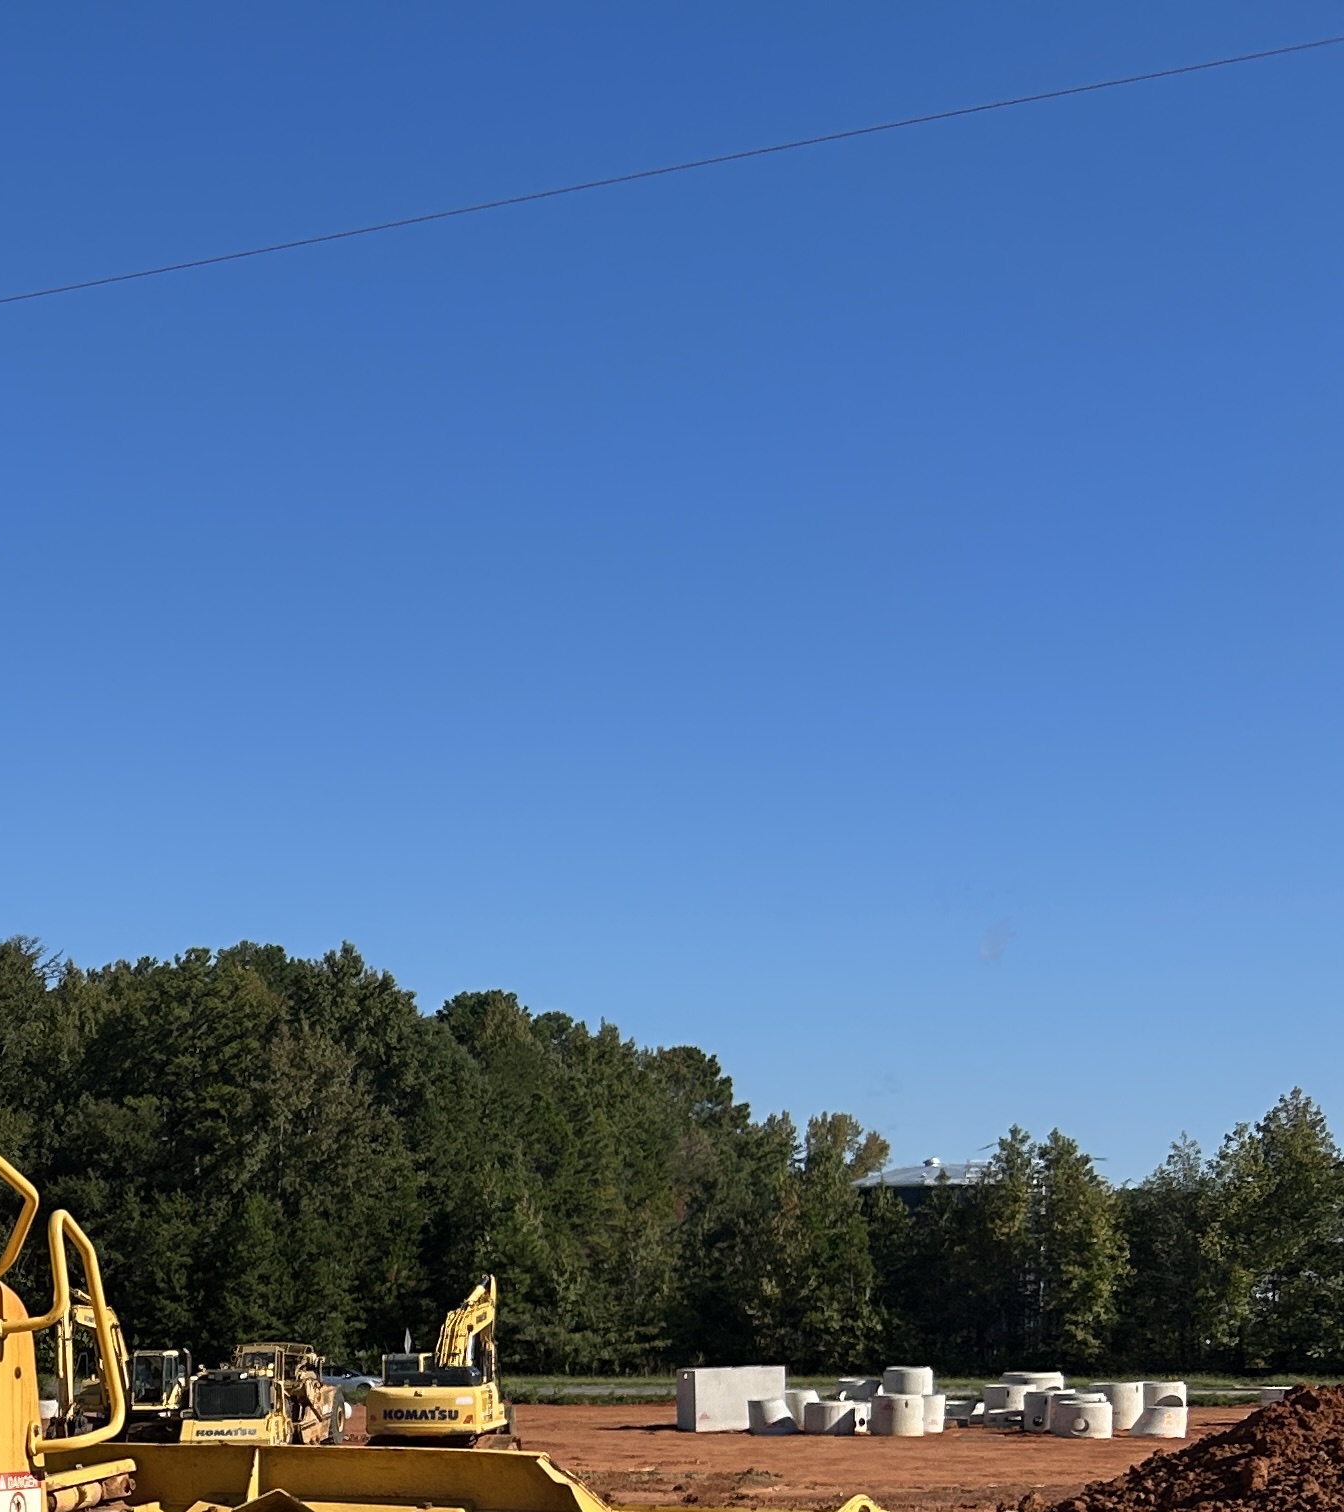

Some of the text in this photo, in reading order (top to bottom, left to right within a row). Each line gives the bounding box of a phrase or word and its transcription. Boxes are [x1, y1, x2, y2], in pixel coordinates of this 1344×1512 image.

[382, 1406, 459, 1420] KOMATSU
[195, 1427, 257, 1437] KOMATSU
[7, 1475, 38, 1490] DANGER
